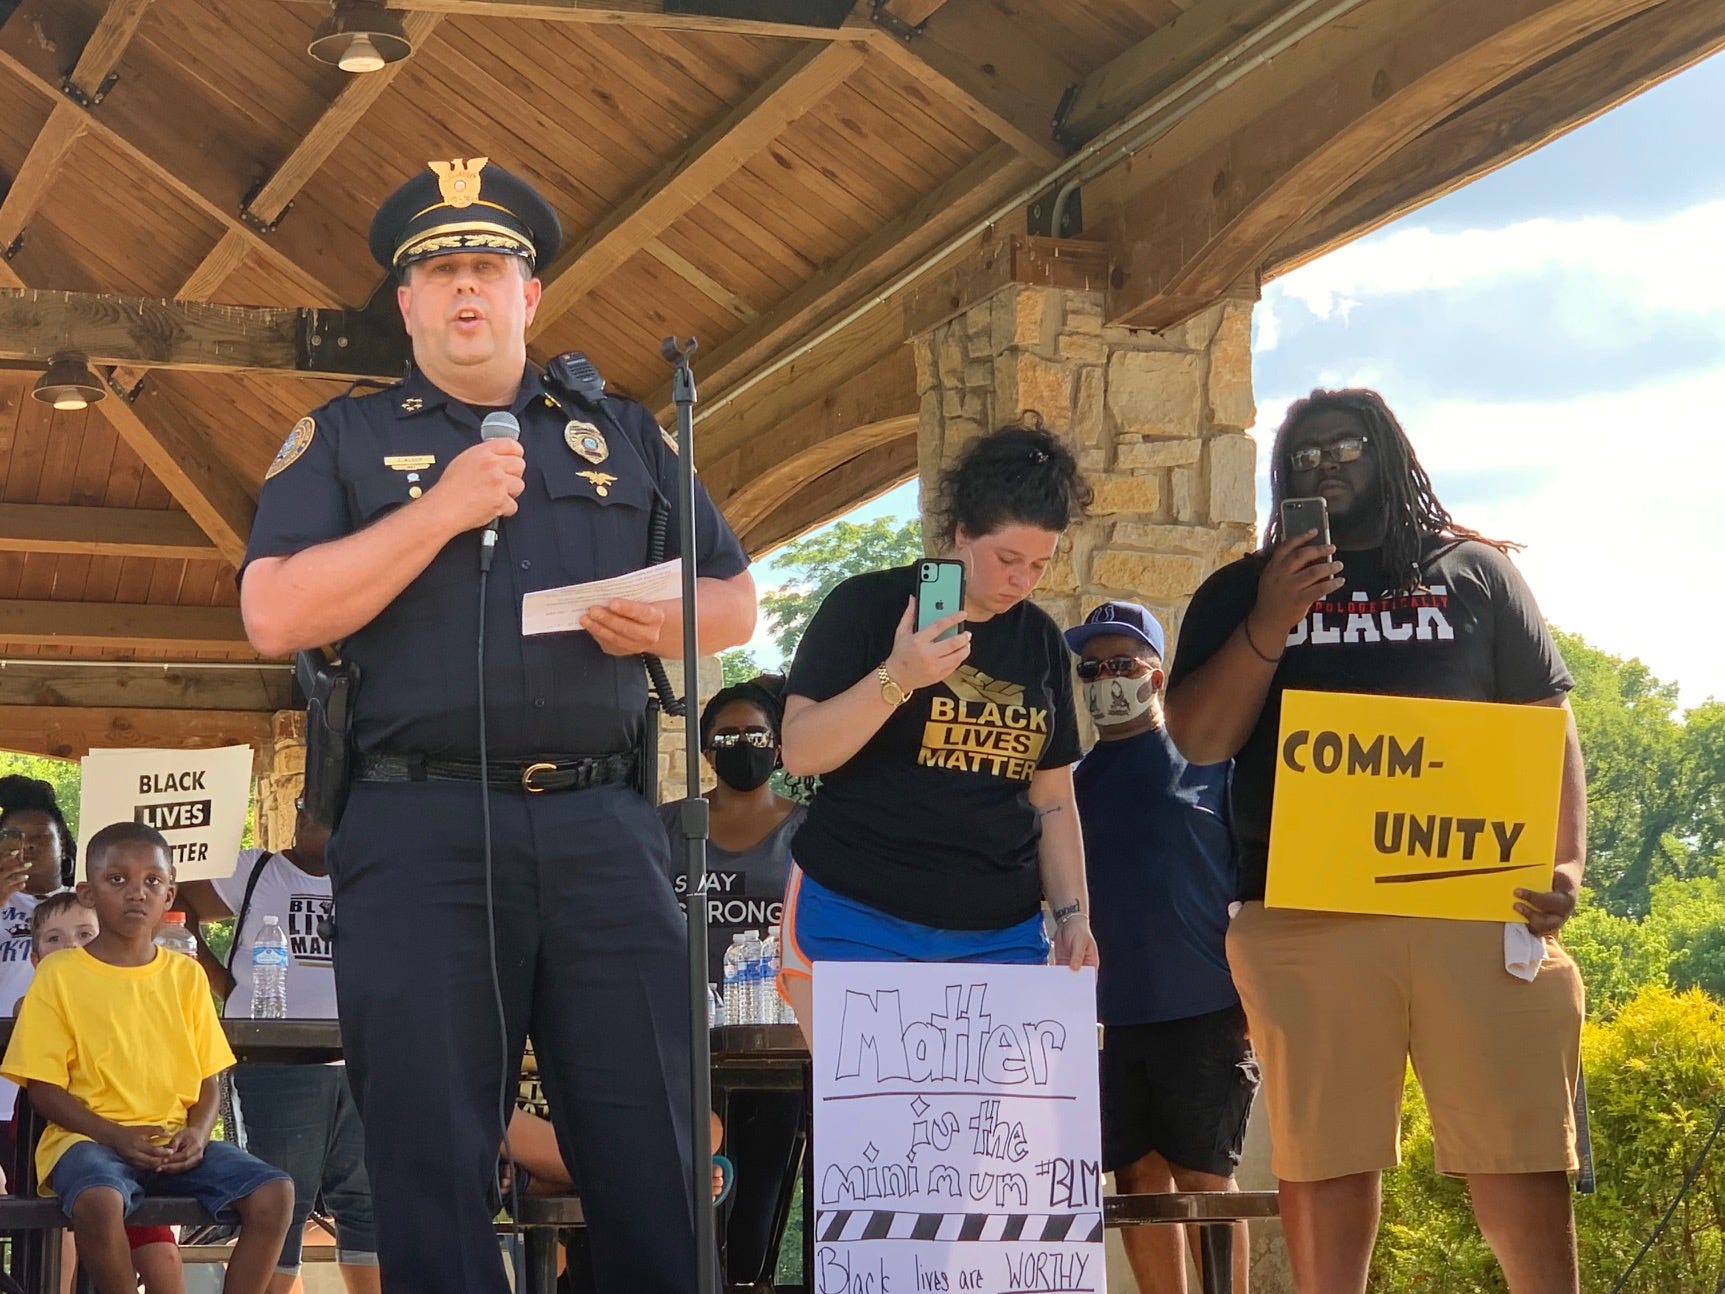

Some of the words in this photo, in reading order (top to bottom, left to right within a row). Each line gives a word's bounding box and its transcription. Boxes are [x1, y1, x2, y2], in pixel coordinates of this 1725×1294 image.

[930, 696, 1047, 732] BLACK
[943, 727, 1032, 754] LIVES
[1282, 729, 1443, 778] COMM-
[917, 746, 1036, 781] MATTER
[139, 770, 206, 794] BLACK
[142, 803, 204, 828] LIVES
[170, 842, 208, 863] TTER
[1374, 811, 1526, 862] UNITY
[674, 872, 737, 893] SAY
[835, 983, 1066, 1085] Matter
[910, 1095, 959, 1151] is
[969, 1100, 1029, 1162] the
[1035, 1158, 1100, 1208] #BLM
[817, 1246, 890, 1294] Black
[914, 1254, 949, 1292] lives
[960, 1269, 984, 1290] are
[1005, 1252, 1089, 1291] WORTHY
